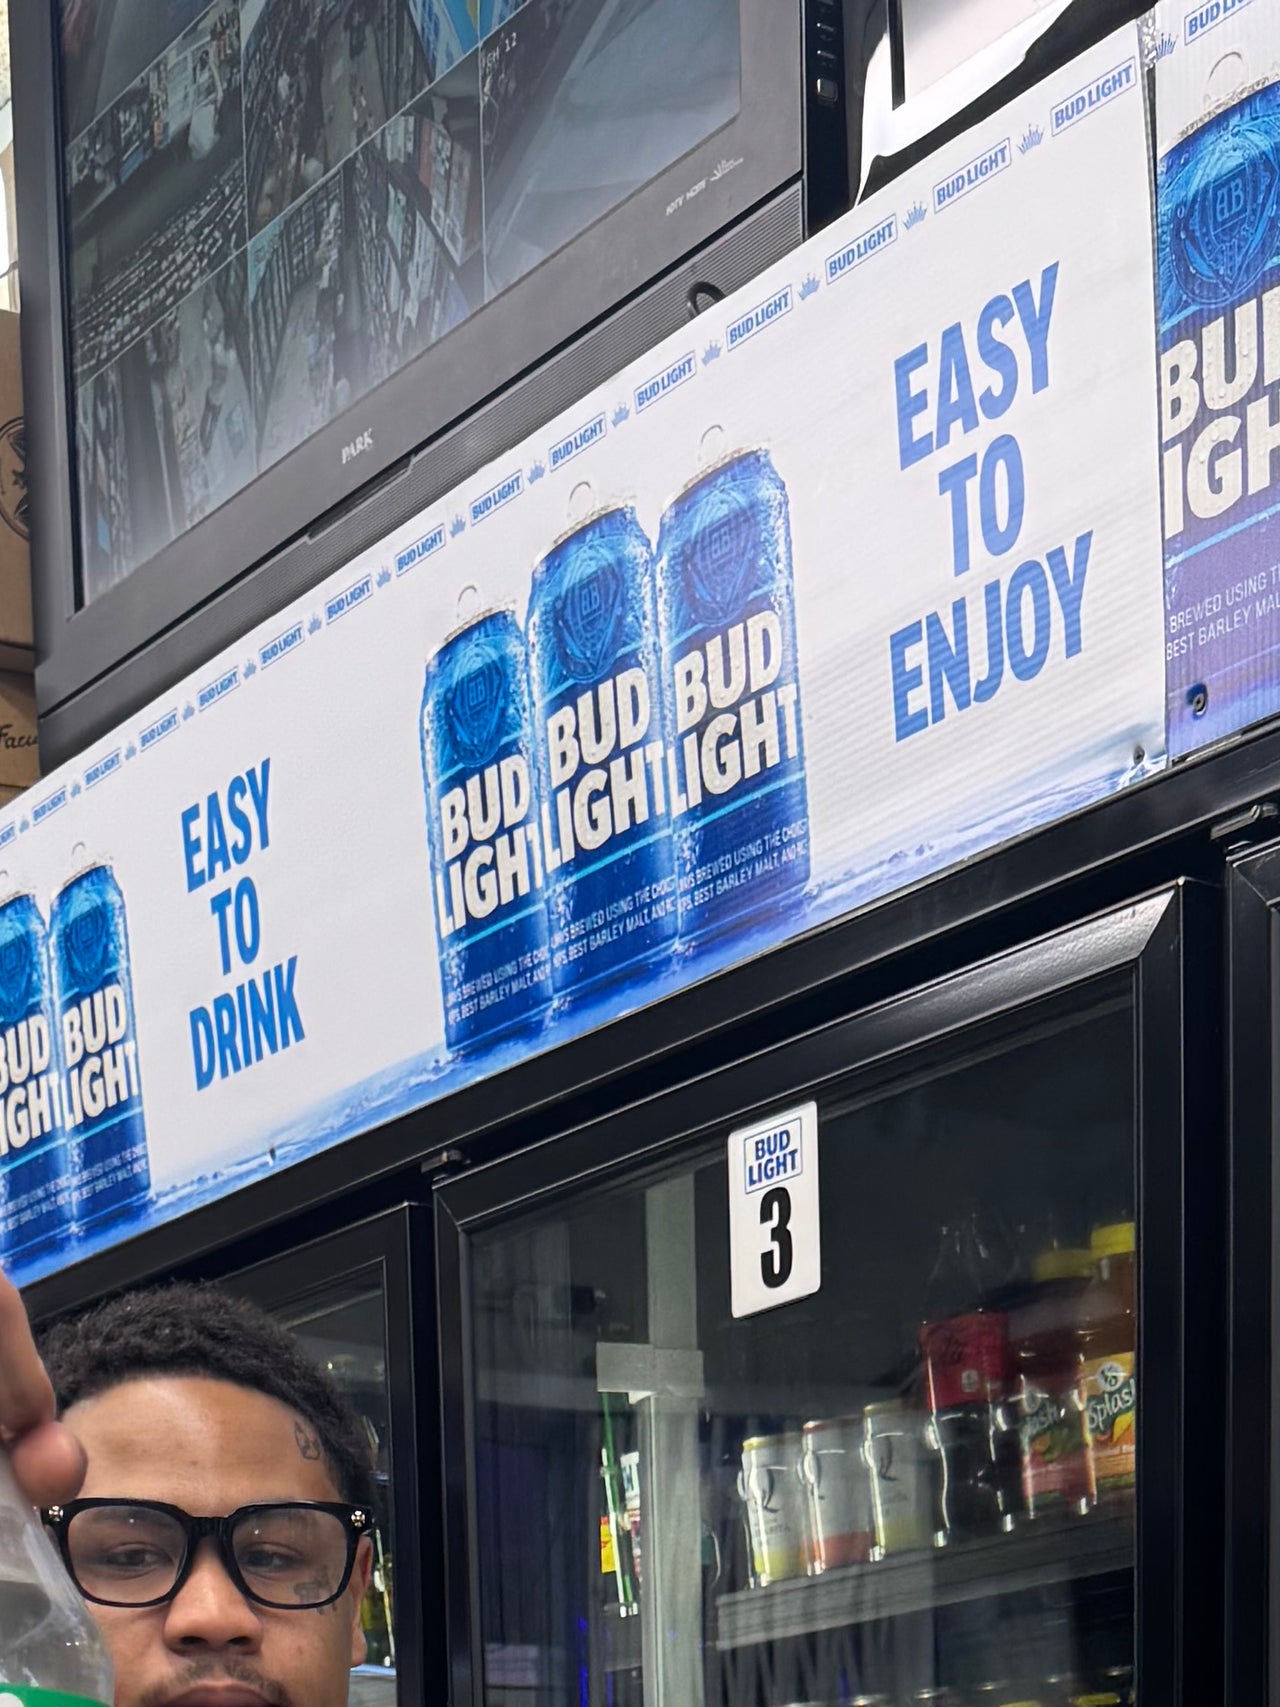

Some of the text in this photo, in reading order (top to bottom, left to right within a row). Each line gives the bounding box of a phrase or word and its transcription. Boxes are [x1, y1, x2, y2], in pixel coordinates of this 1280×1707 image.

[1189, 2, 1221, 36] BUD
[1054, 66, 1134, 128] BUD LIGHT
[828, 222, 895, 278] BUD LIGHT
[729, 293, 790, 345] BUD LIGHT
[894, 261, 1059, 472] EASY
[552, 420, 605, 466] BUD LIGHT
[939, 434, 1024, 576] TO
[674, 611, 784, 721] BUD
[889, 530, 1094, 743] ENJOY
[548, 666, 651, 789] BUD
[666, 684, 797, 820] LIGHT
[181, 758, 270, 893] EASY
[441, 754, 527, 861] BUD
[541, 740, 666, 873] LIGHT
[211, 876, 260, 977] TO
[435, 824, 541, 938] LIGHT
[63, 985, 126, 1060] BUD
[189, 955, 305, 1091] DRINK
[60, 1041, 139, 1130] LIGHT
[748, 1149, 799, 1187] LIGHT
[755, 1131, 790, 1161] BUD
[760, 1187, 793, 1289] 3
[1089, 1374, 1136, 1433] Splas
